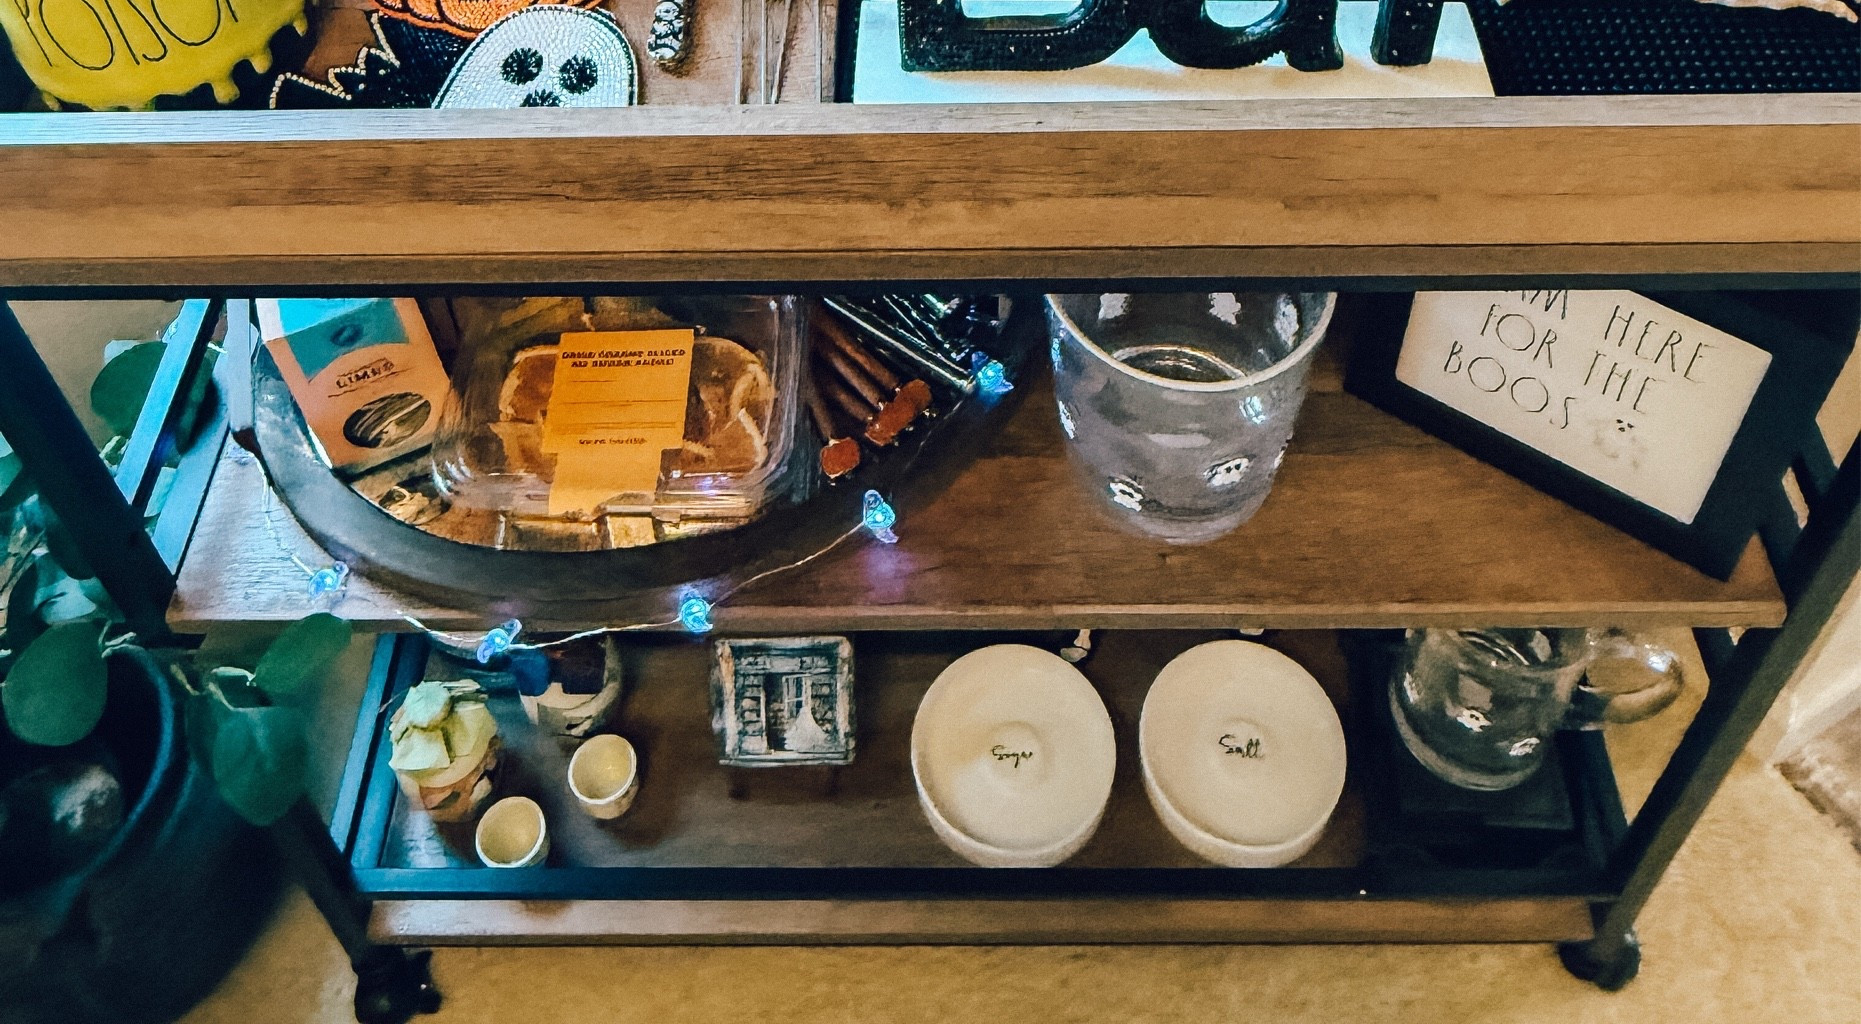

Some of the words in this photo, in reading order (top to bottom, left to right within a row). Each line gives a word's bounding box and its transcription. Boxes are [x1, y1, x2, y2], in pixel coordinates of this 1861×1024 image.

[1443, 340, 1577, 430] BOOS
[1480, 303, 1558, 369] FOR
[1583, 348, 1666, 415] THE
[1604, 304, 1718, 384] HERE
